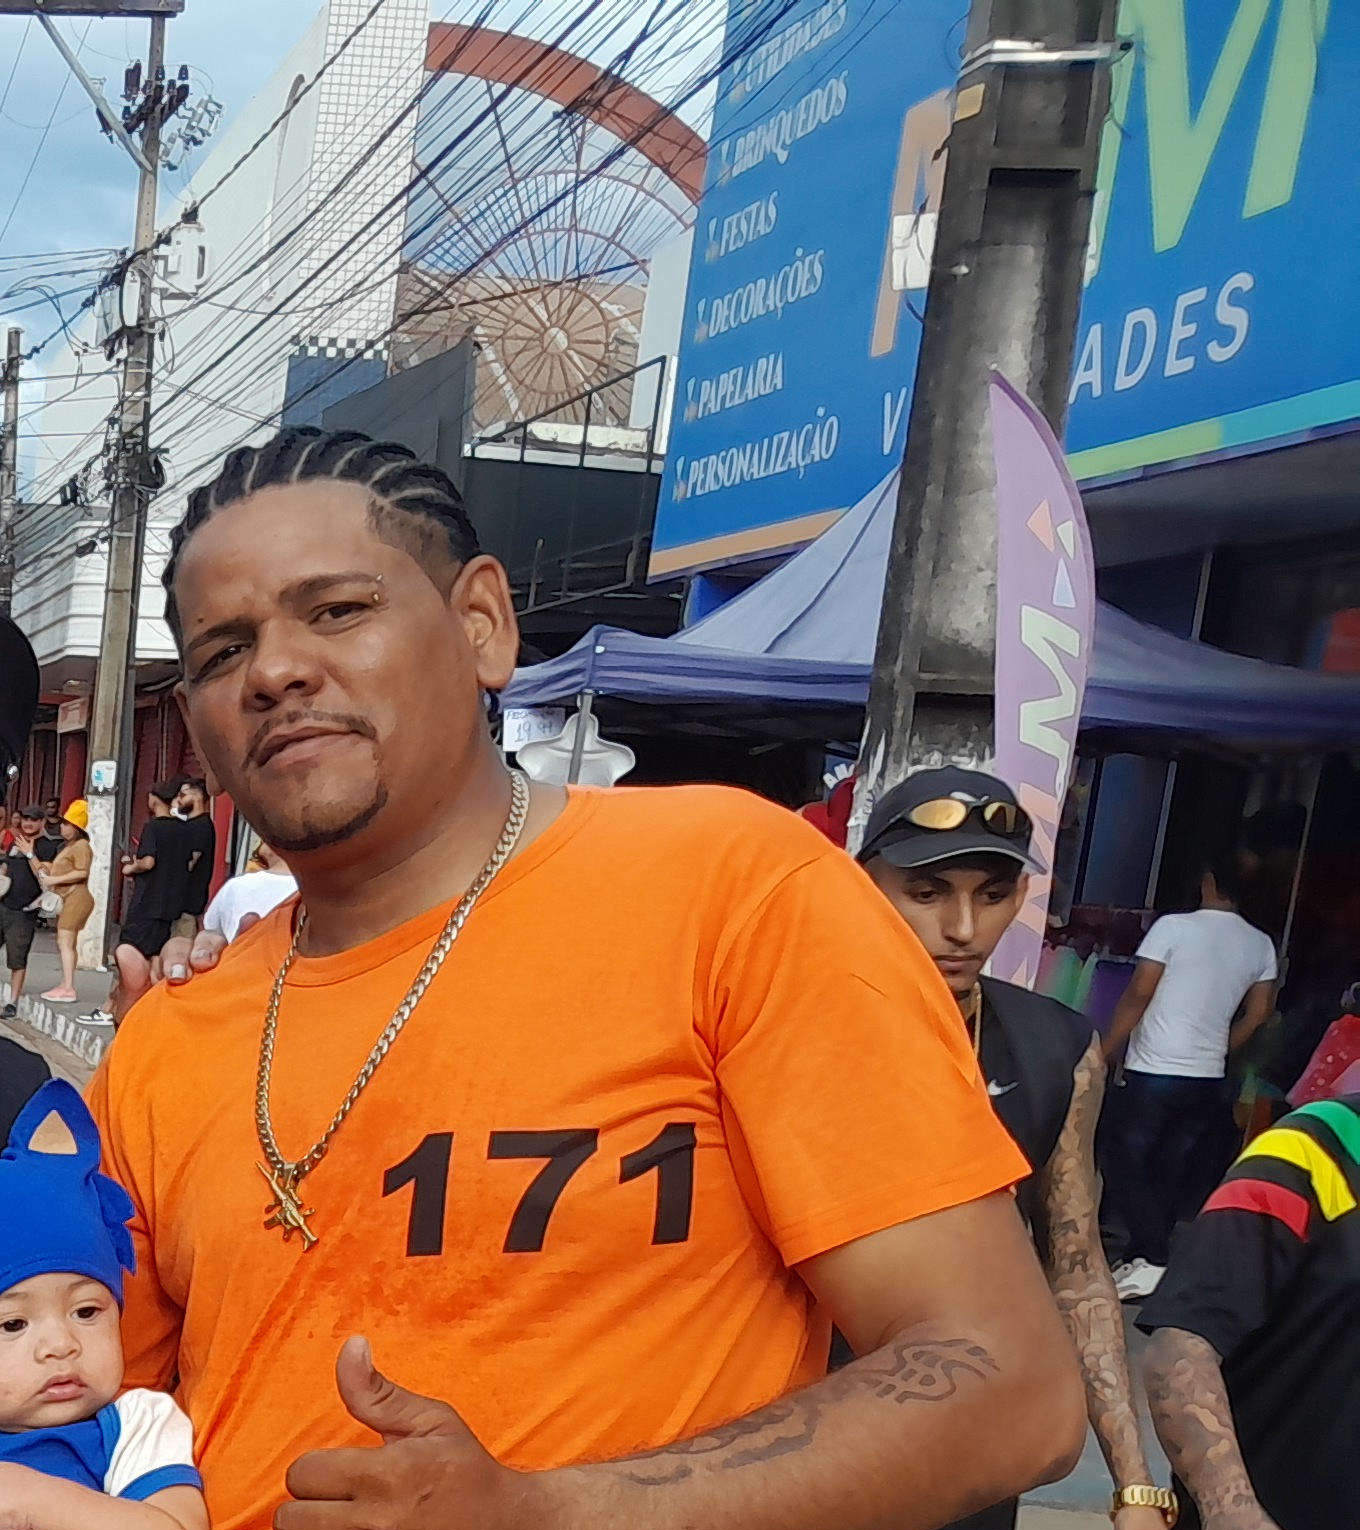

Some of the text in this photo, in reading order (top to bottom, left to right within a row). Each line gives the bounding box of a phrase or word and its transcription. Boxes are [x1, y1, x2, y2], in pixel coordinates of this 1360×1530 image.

[731, 69, 849, 178] BRINQUEDOS
[719, 190, 778, 257] FESTAS
[697, 350, 783, 419] PAPELARIA
[686, 405, 839, 499] PERSONALIZAÇÃO
[381, 1121, 698, 1258] 171
